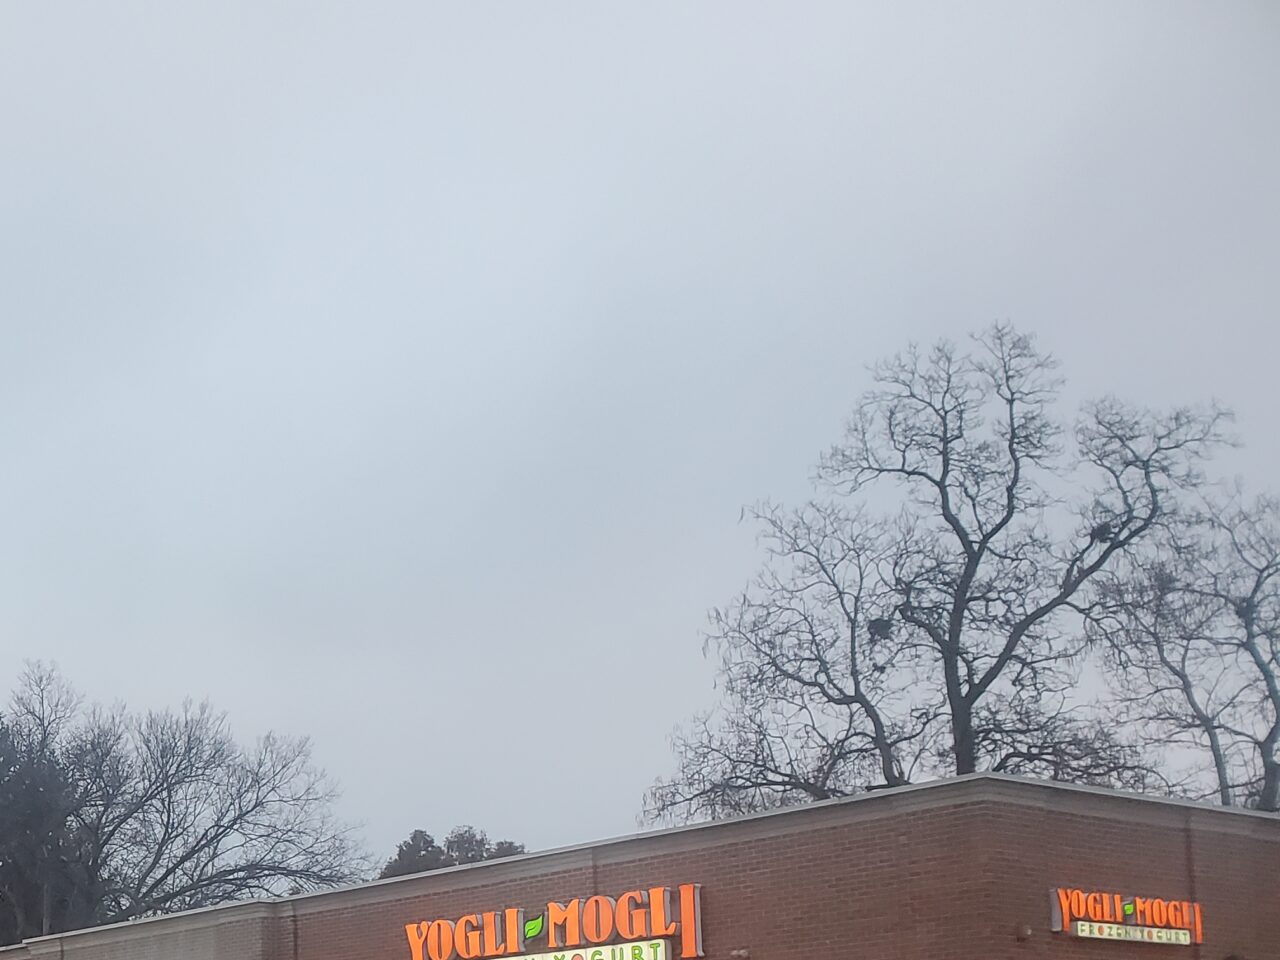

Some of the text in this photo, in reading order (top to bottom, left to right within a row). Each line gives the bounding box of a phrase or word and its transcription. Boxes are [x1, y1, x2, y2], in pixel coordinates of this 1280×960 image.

[547, 883, 698, 958] MOGLI
[1057, 888, 1202, 944] YOGLI MOGLI
